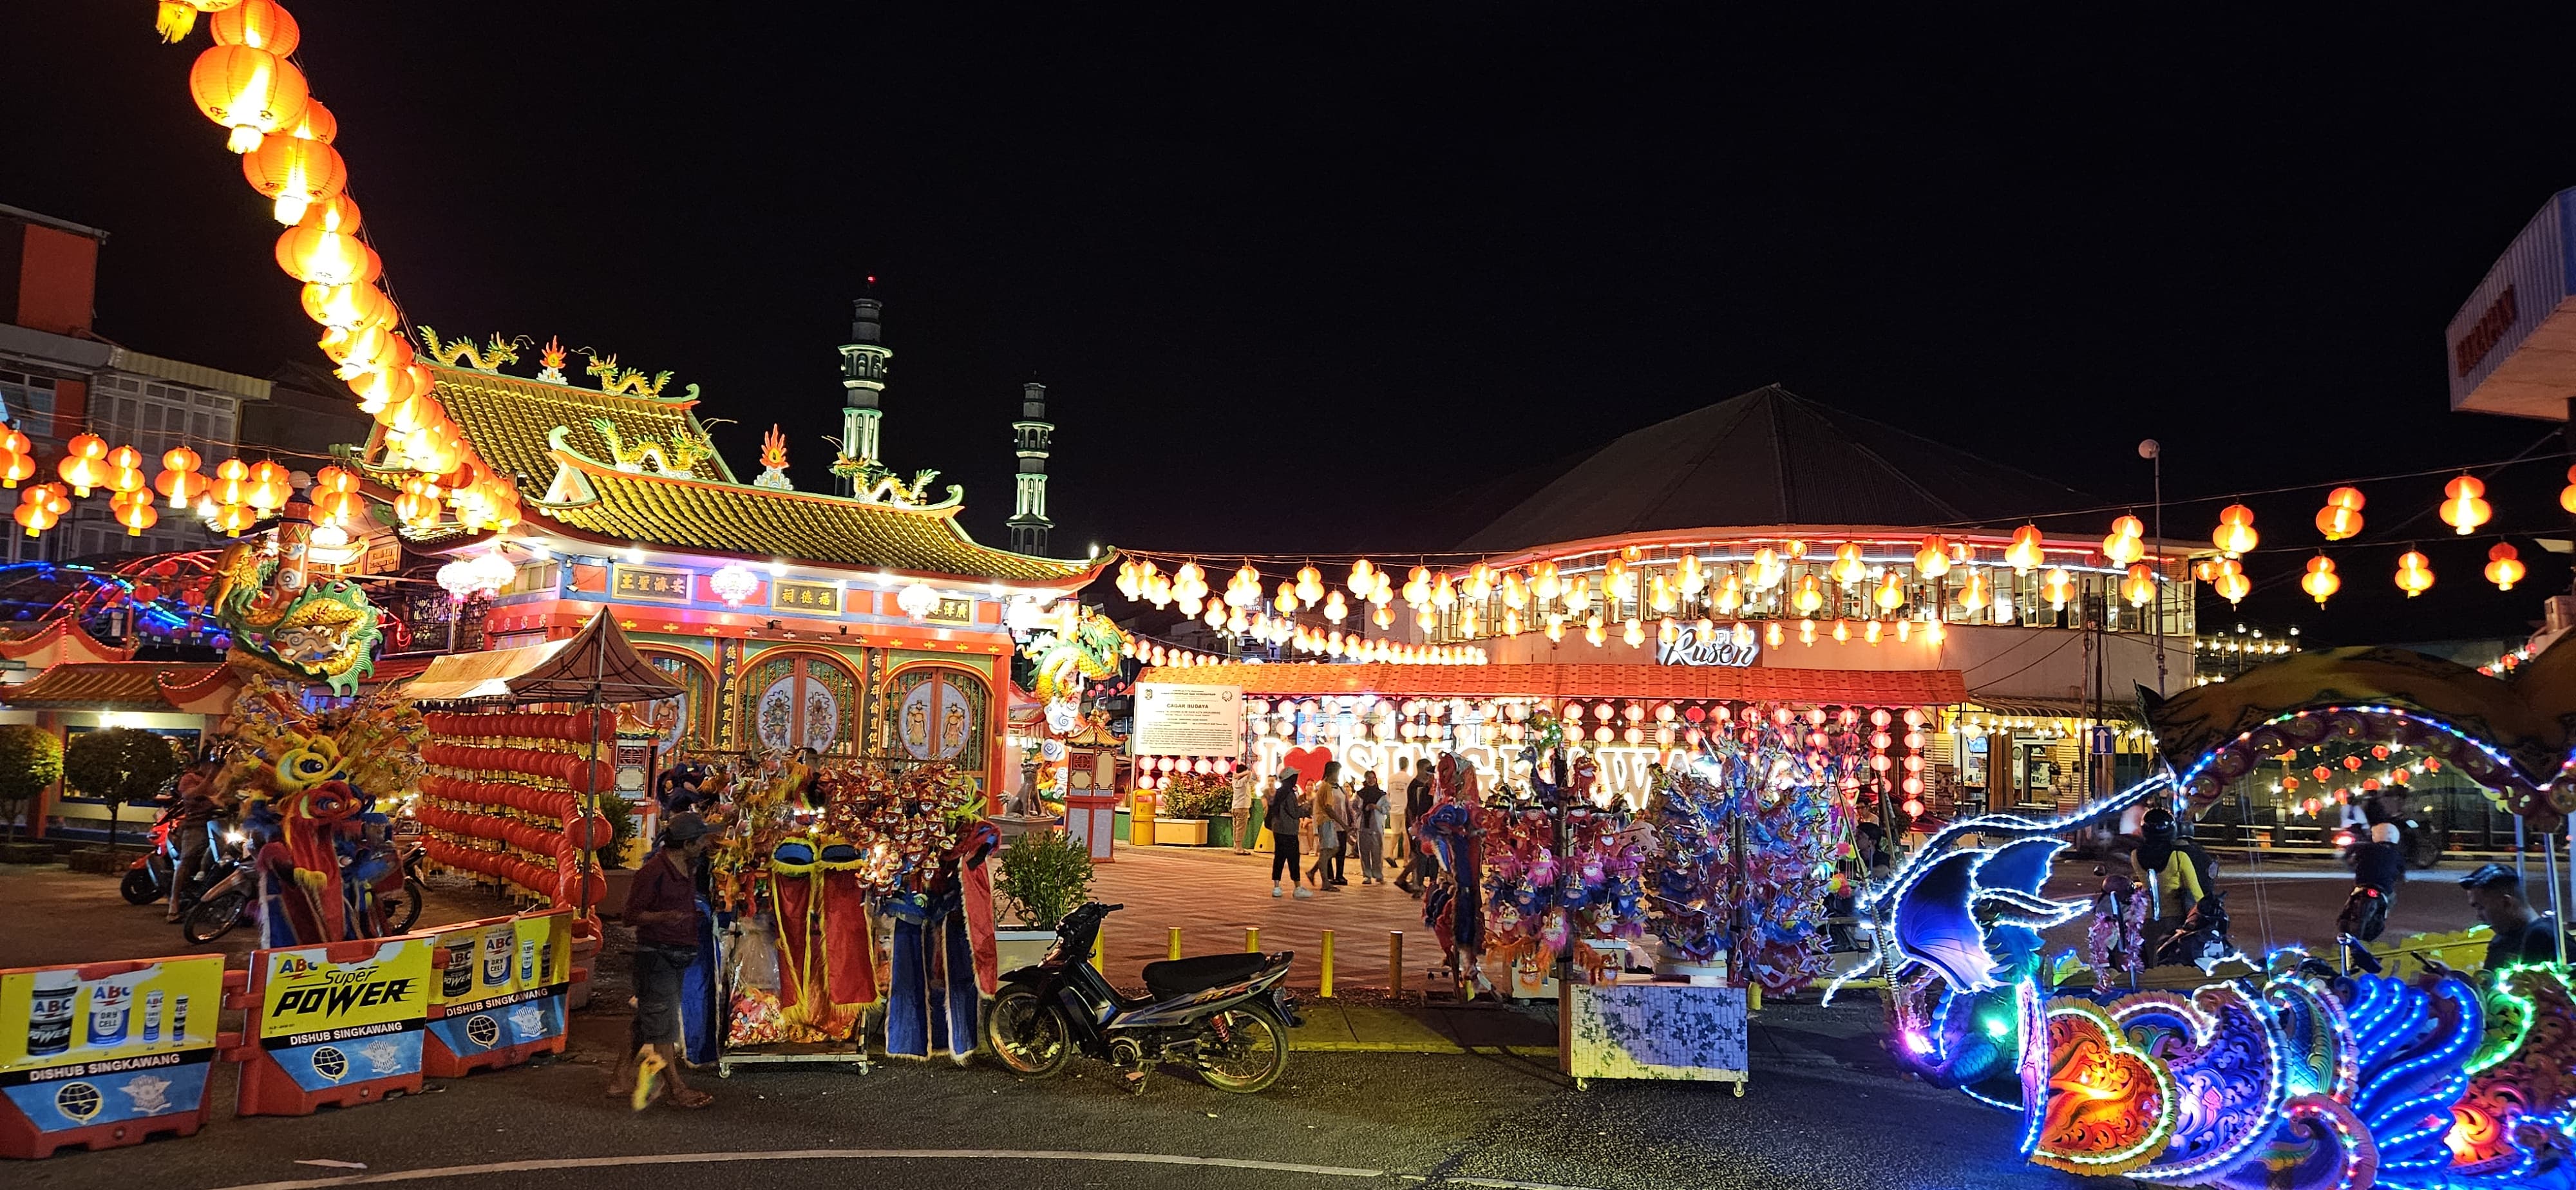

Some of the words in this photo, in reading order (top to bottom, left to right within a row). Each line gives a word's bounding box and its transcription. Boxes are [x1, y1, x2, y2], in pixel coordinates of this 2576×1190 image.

[1663, 627, 1752, 666] Rusen
[486, 936, 513, 950] ABC
[279, 958, 318, 974] ABC
[321, 966, 379, 986] Super
[443, 973, 471, 987] POWER
[93, 986, 131, 999] ABC
[272, 978, 417, 1019] POWER
[34, 997, 71, 1014] ABC
[446, 1002, 483, 1017] DISHUB
[486, 988, 548, 1009] SINGKAWANG
[98, 1019, 118, 1028] CELL
[100, 1011, 118, 1019] DRY
[290, 1032, 331, 1046] DISHUB
[334, 1022, 402, 1039] SINGKAWANG
[30, 1065, 85, 1082] DISHUB
[88, 1053, 180, 1074] SINGKAWANG
